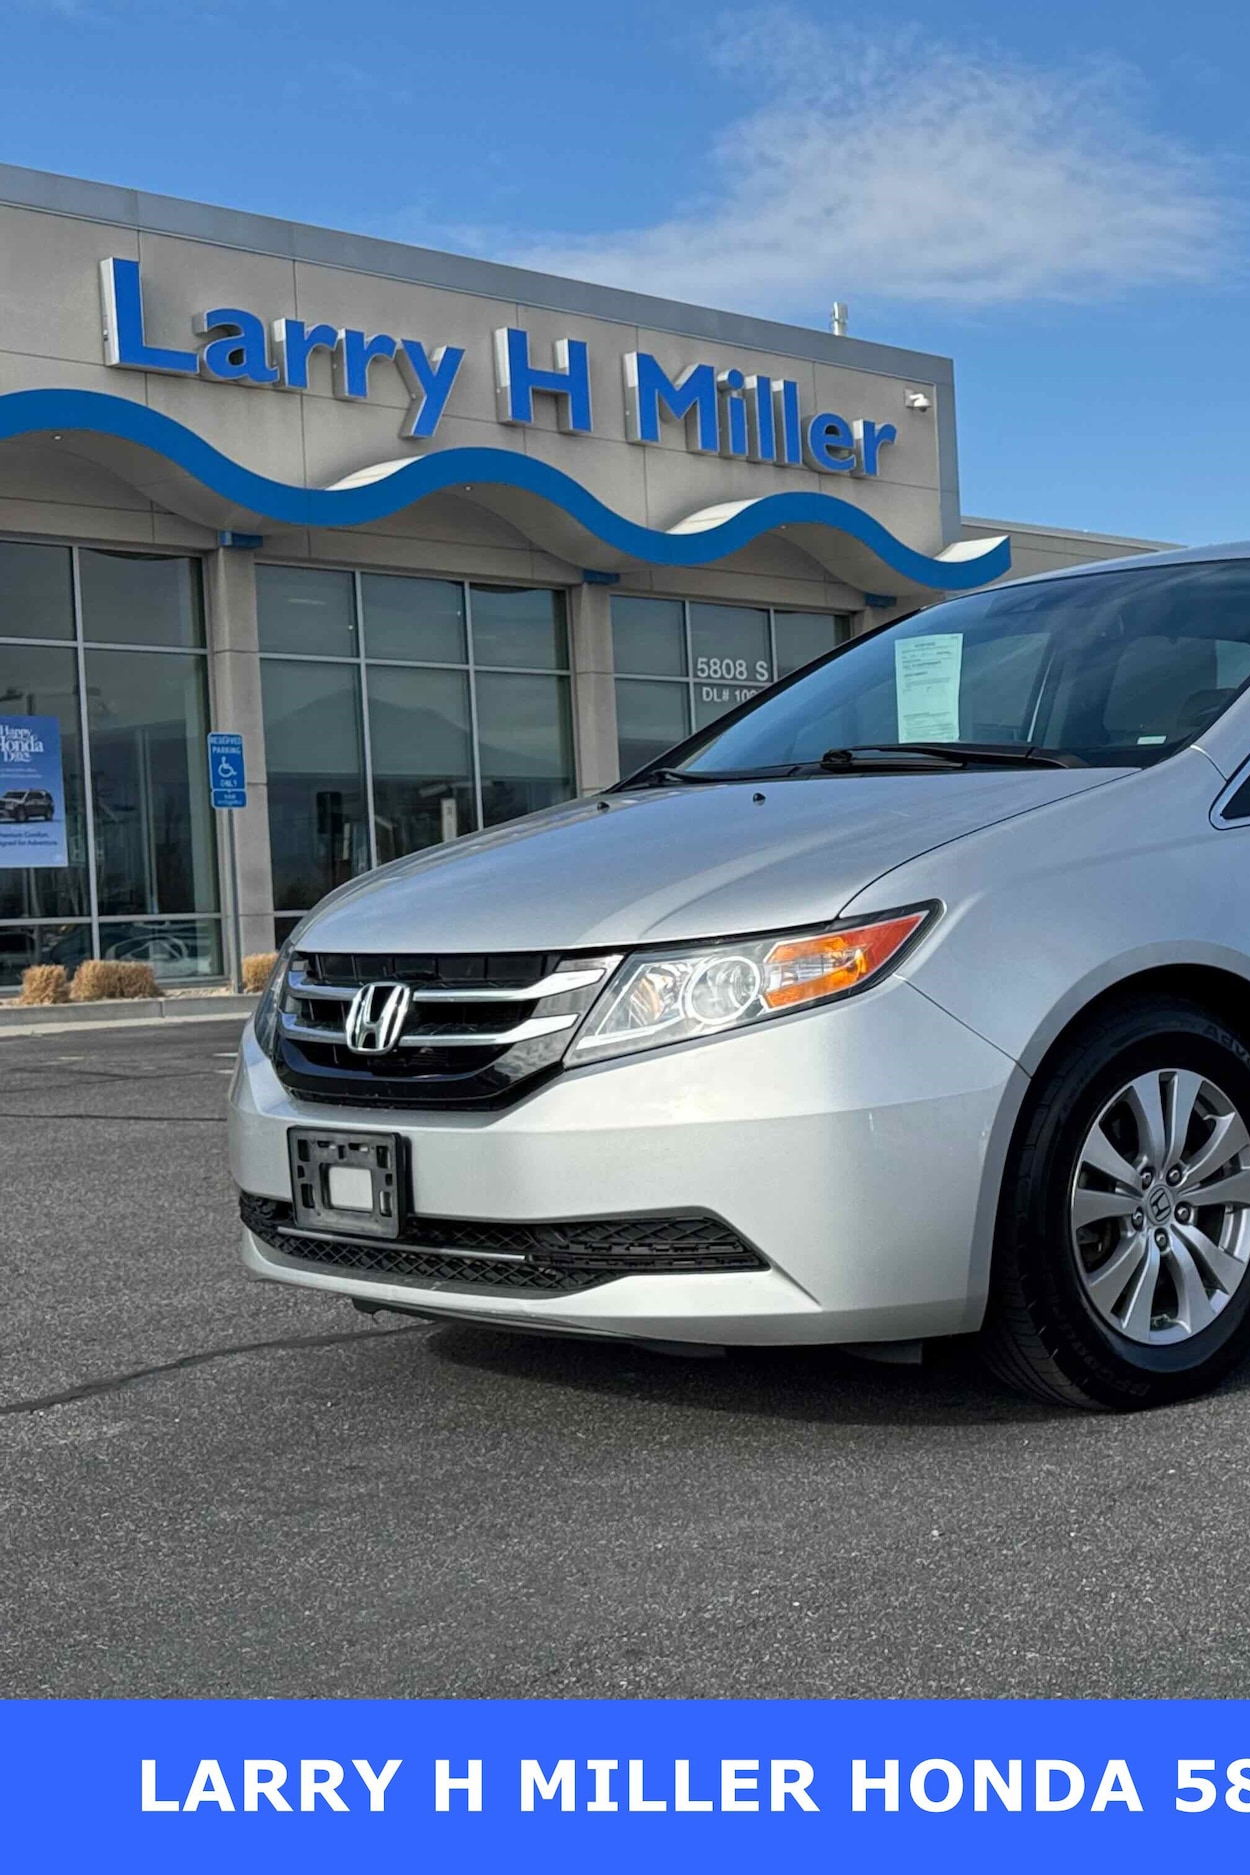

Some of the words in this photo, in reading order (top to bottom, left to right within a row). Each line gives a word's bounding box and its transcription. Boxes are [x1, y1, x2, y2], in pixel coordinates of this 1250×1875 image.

[102, 257, 465, 439] Larry
[497, 327, 591, 432] H
[625, 353, 897, 476] Miller
[697, 658, 747, 680] 5808
[755, 660, 769, 681] S
[702, 686, 730, 703] DL#
[210, 736, 242, 745] RESERVED
[212, 745, 242, 755] PARKING
[220, 778, 238, 788] ONLY
